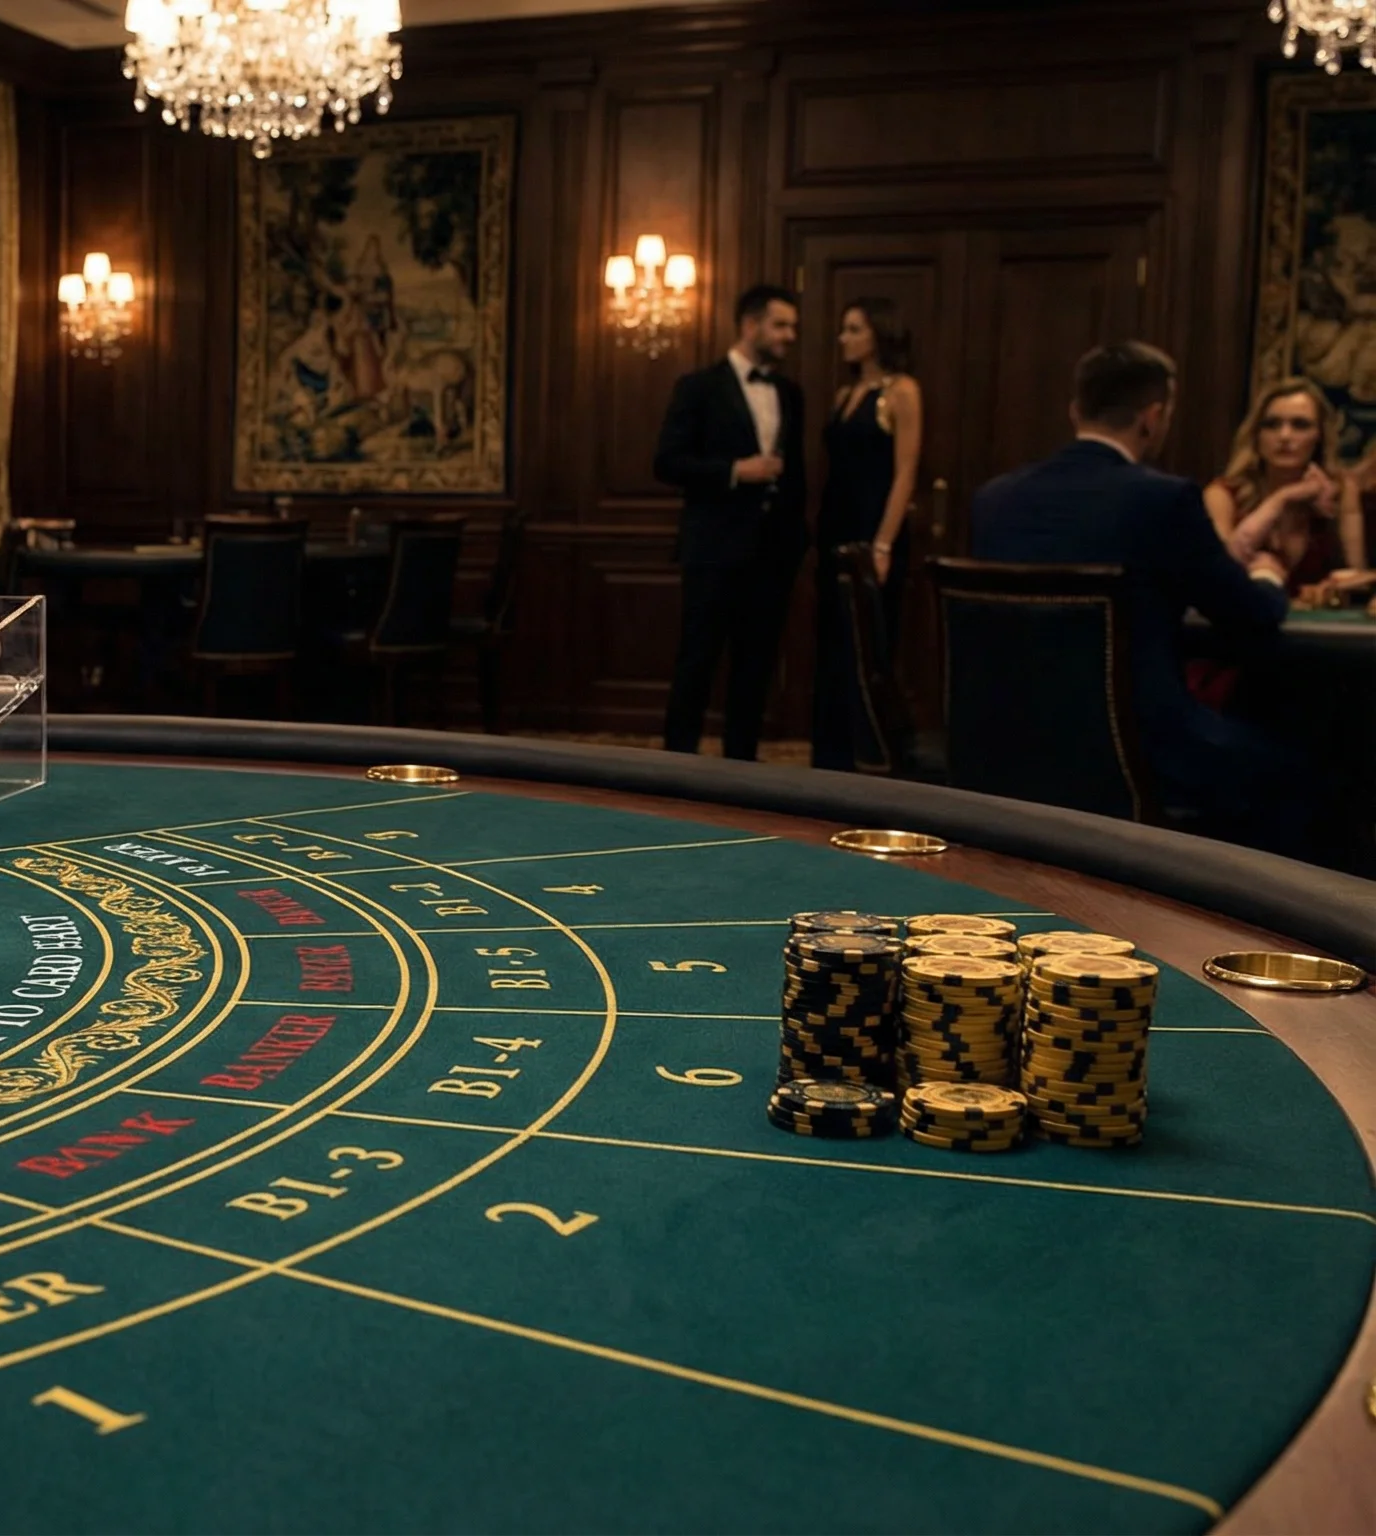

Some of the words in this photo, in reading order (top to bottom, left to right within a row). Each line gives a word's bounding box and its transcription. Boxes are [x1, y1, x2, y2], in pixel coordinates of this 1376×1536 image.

[12, 954, 83, 999] CARD
[647, 959, 728, 973] 5
[199, 1015, 337, 1091] BANKER
[655, 1065, 743, 1087] 6
[484, 1202, 600, 1237] 2
[31, 1385, 147, 1435] 1
